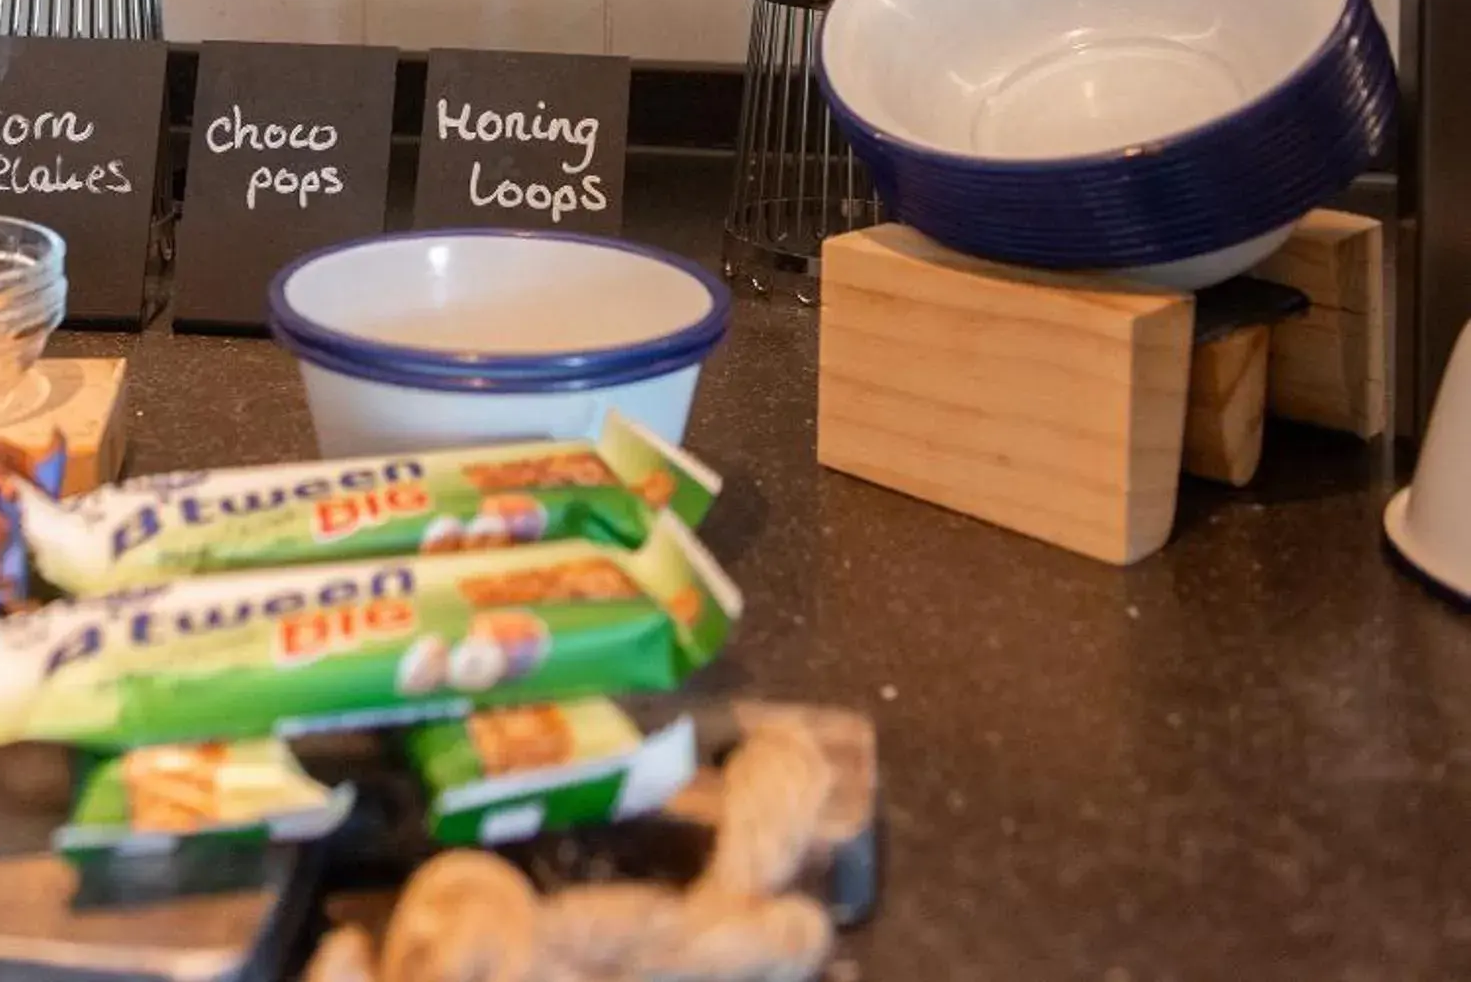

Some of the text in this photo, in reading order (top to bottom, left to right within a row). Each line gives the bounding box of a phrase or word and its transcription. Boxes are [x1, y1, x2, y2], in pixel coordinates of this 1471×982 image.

[437, 98, 599, 174] Honing
[246, 166, 344, 210] pops
[314, 488, 429, 534] BIG
[278, 596, 415, 657] BIG
